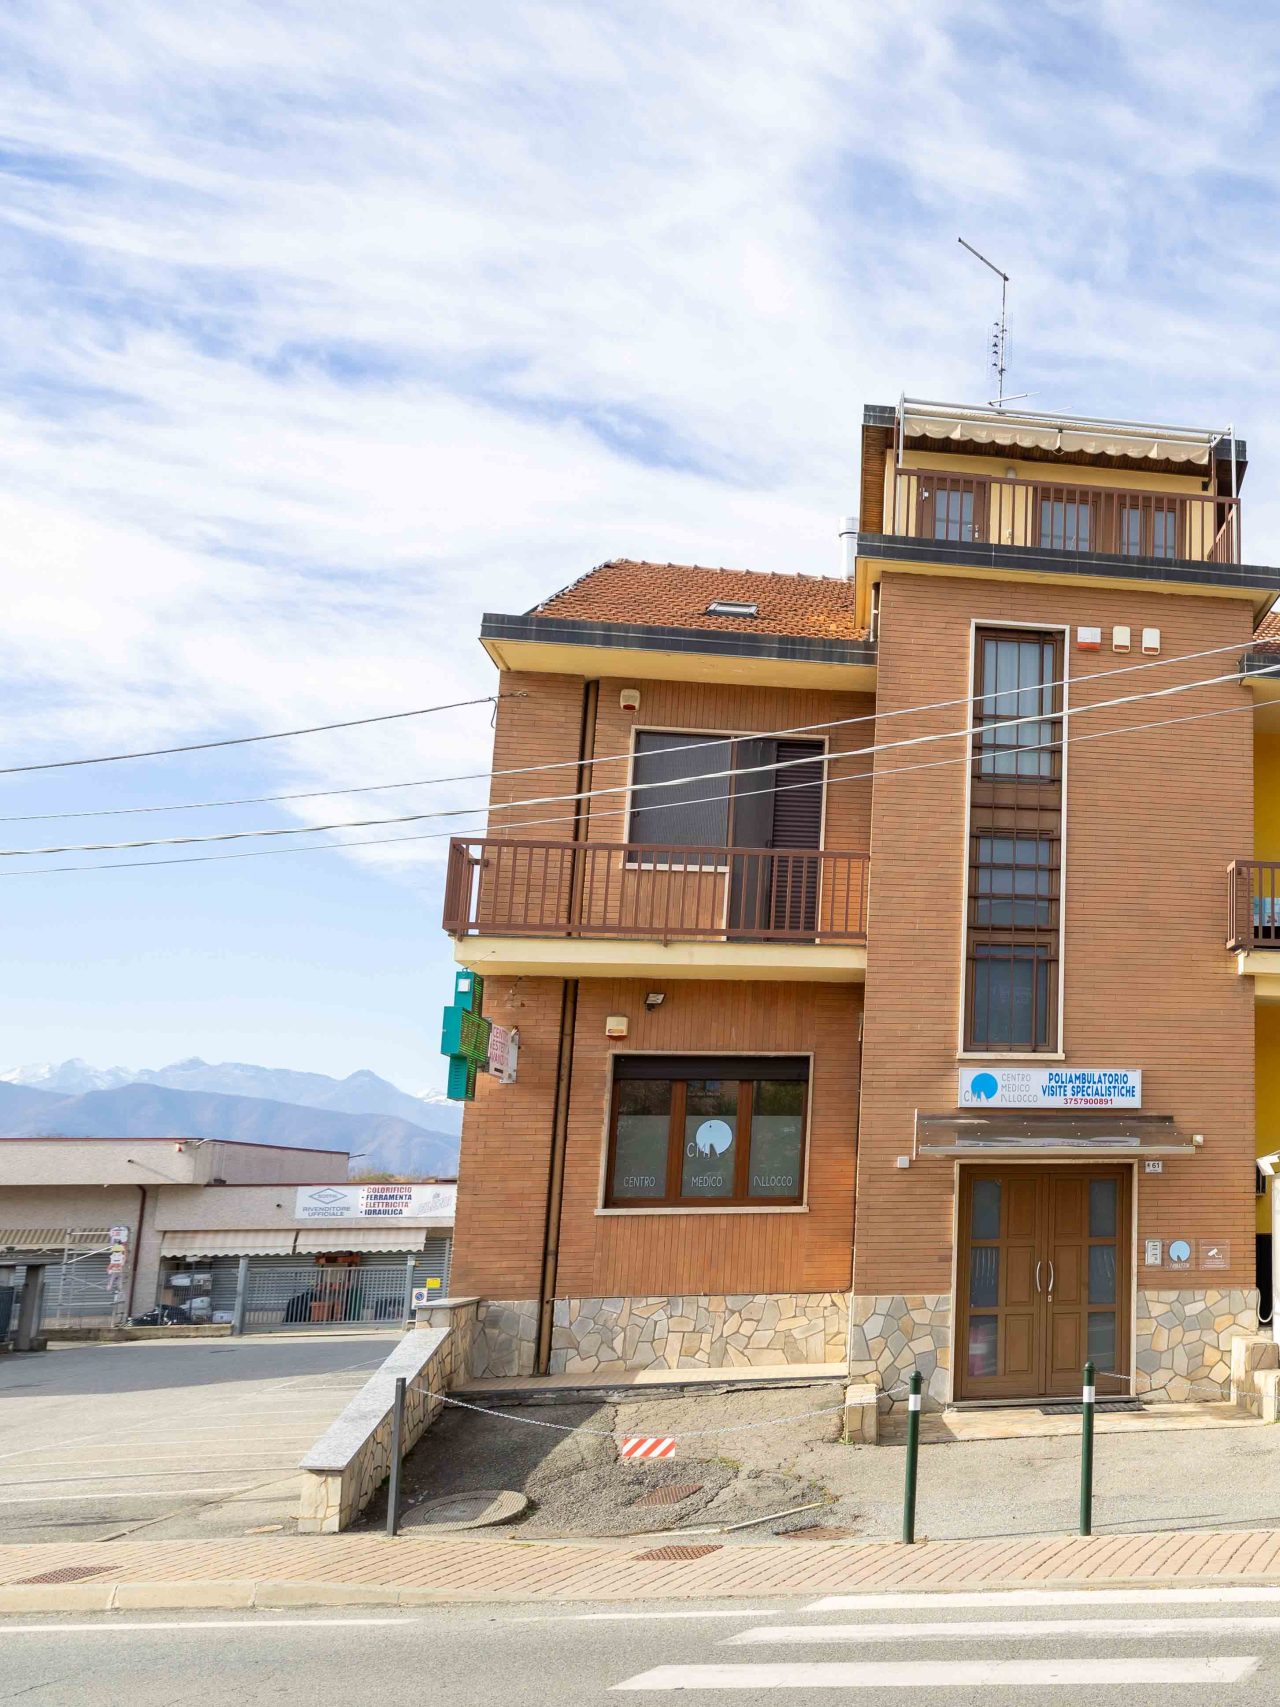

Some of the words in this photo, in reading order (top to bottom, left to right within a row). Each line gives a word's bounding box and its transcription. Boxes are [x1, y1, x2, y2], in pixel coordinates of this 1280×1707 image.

[1001, 1073, 1031, 1082] CENTRO
[1048, 1072, 1129, 1085] POLIAMBULATORIO
[1001, 1084, 1031, 1093] MEDICO
[1041, 1085, 1068, 1097] VISITE
[1071, 1085, 1136, 1098] SPECIALISTICHE
[1000, 1094, 1038, 1103] ALLOCCO
[1063, 1097, 1114, 1105] 3757900891
[623, 1176, 656, 1187] CENTRO
[691, 1176, 723, 1187] MEDICO
[753, 1176, 793, 1187] ALLOCCO
[366, 1186, 412, 1194] COLORIFICIO
[364, 1208, 404, 1216] IDRAULICA
